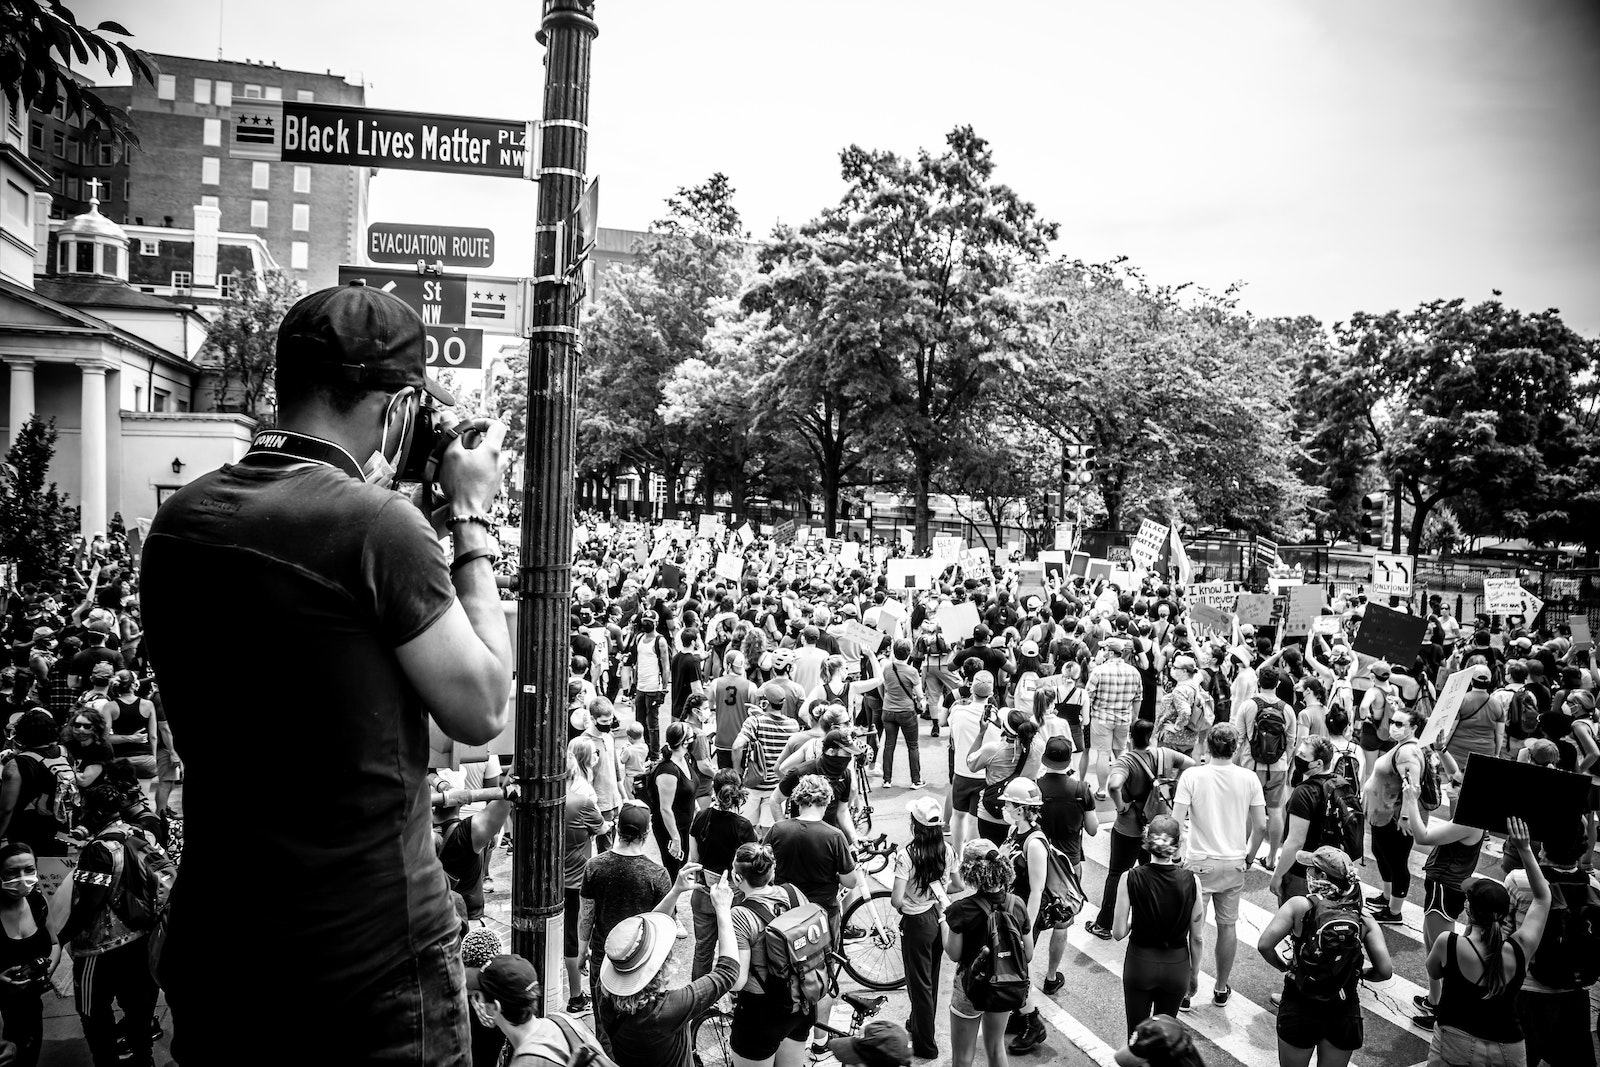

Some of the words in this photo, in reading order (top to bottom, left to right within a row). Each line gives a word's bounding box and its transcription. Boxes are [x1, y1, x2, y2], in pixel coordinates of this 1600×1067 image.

[285, 114, 349, 154] Black
[357, 119, 414, 160] Lives
[421, 124, 491, 165] Matter
[498, 129, 525, 146] PLZ
[500, 149, 524, 167] NW
[371, 232, 446, 256] EVACUATION
[452, 236, 490, 258] ROUTE
[422, 280, 442, 301] St
[422, 304, 442, 324] NW
[1140, 529, 1163, 544] LIVES
[1143, 520, 1167, 535] BLACK
[1135, 549, 1153, 560] VOTE
[1188, 585, 1197, 596] I
[1199, 584, 1222, 595] know
[1223, 583, 1231, 594] I
[1209, 595, 1235, 605] never
[724, 685, 738, 706] 3
